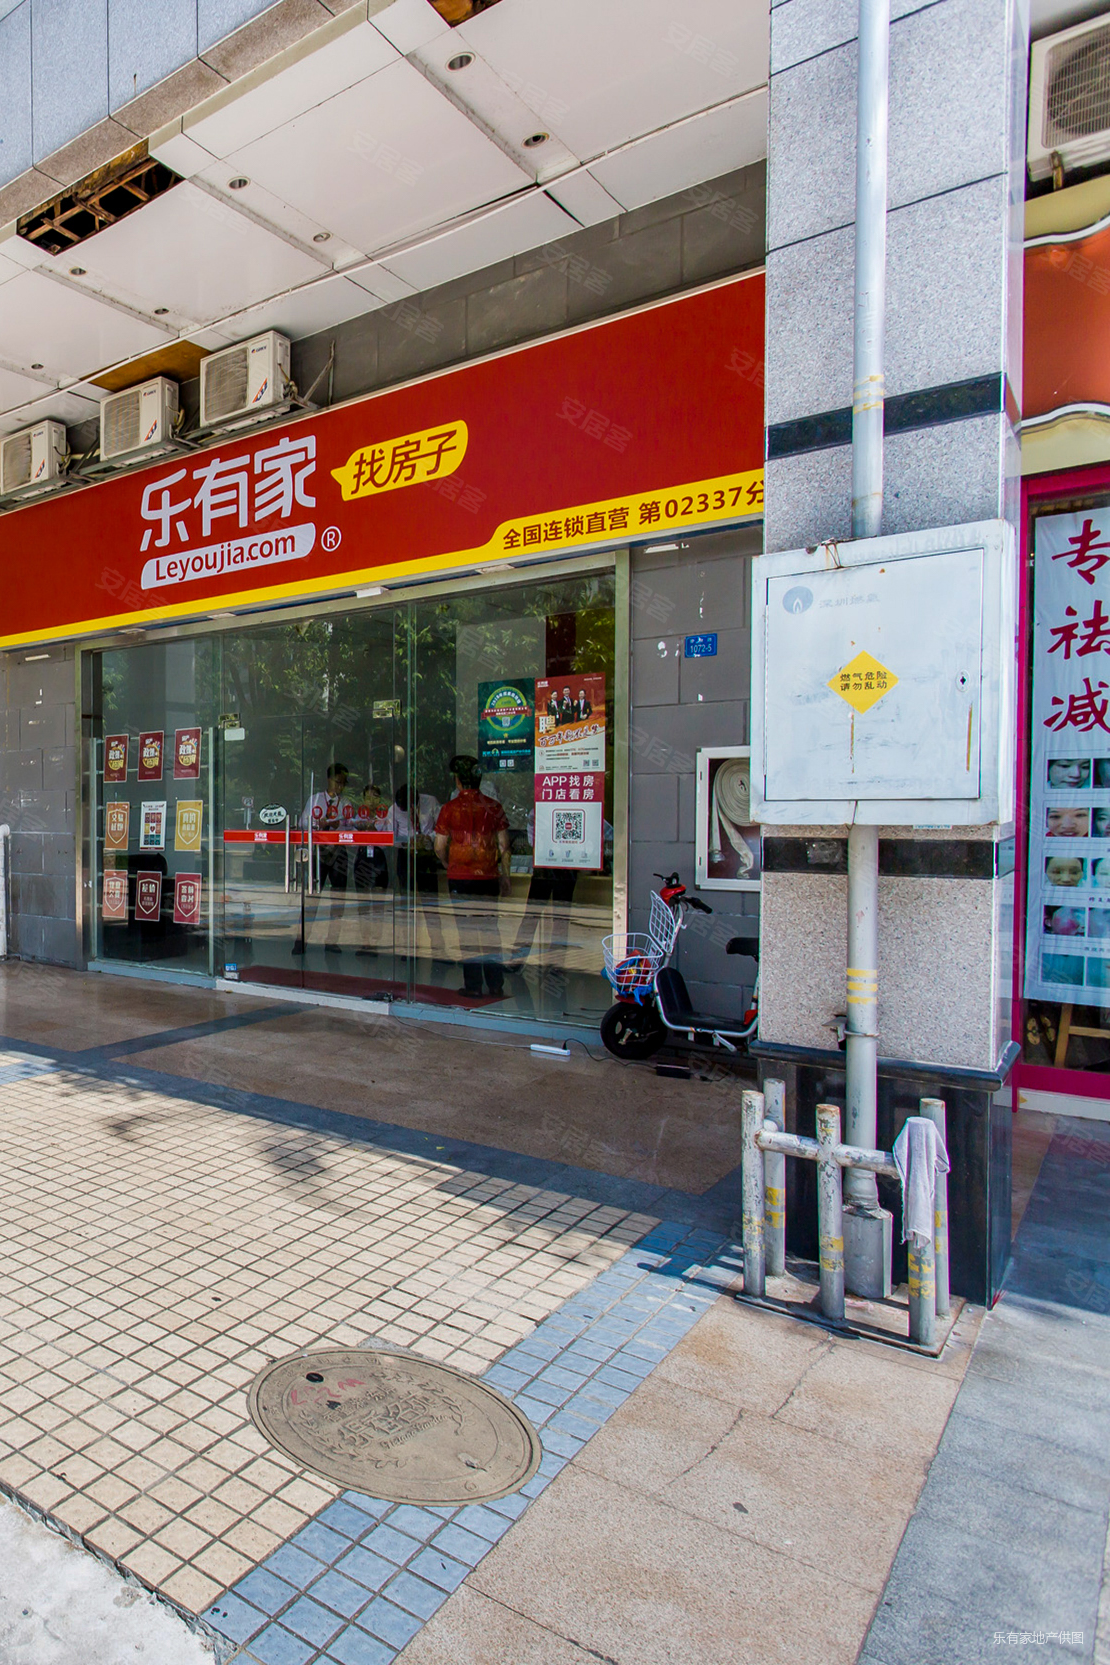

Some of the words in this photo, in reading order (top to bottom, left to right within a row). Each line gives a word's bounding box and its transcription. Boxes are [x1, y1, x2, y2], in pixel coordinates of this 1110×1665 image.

[350, 430, 458, 495] 找房子
[139, 434, 317, 552] 乐有家
[502, 507, 630, 550] 全国连锁直营
[154, 534, 297, 582] Leyoujia.com
[839, 671, 887, 682] 燃气危险
[840, 680, 887, 691] 请勿乱动
[542, 774, 595, 787] APP找房
[542, 788, 595, 800] 门店看房
